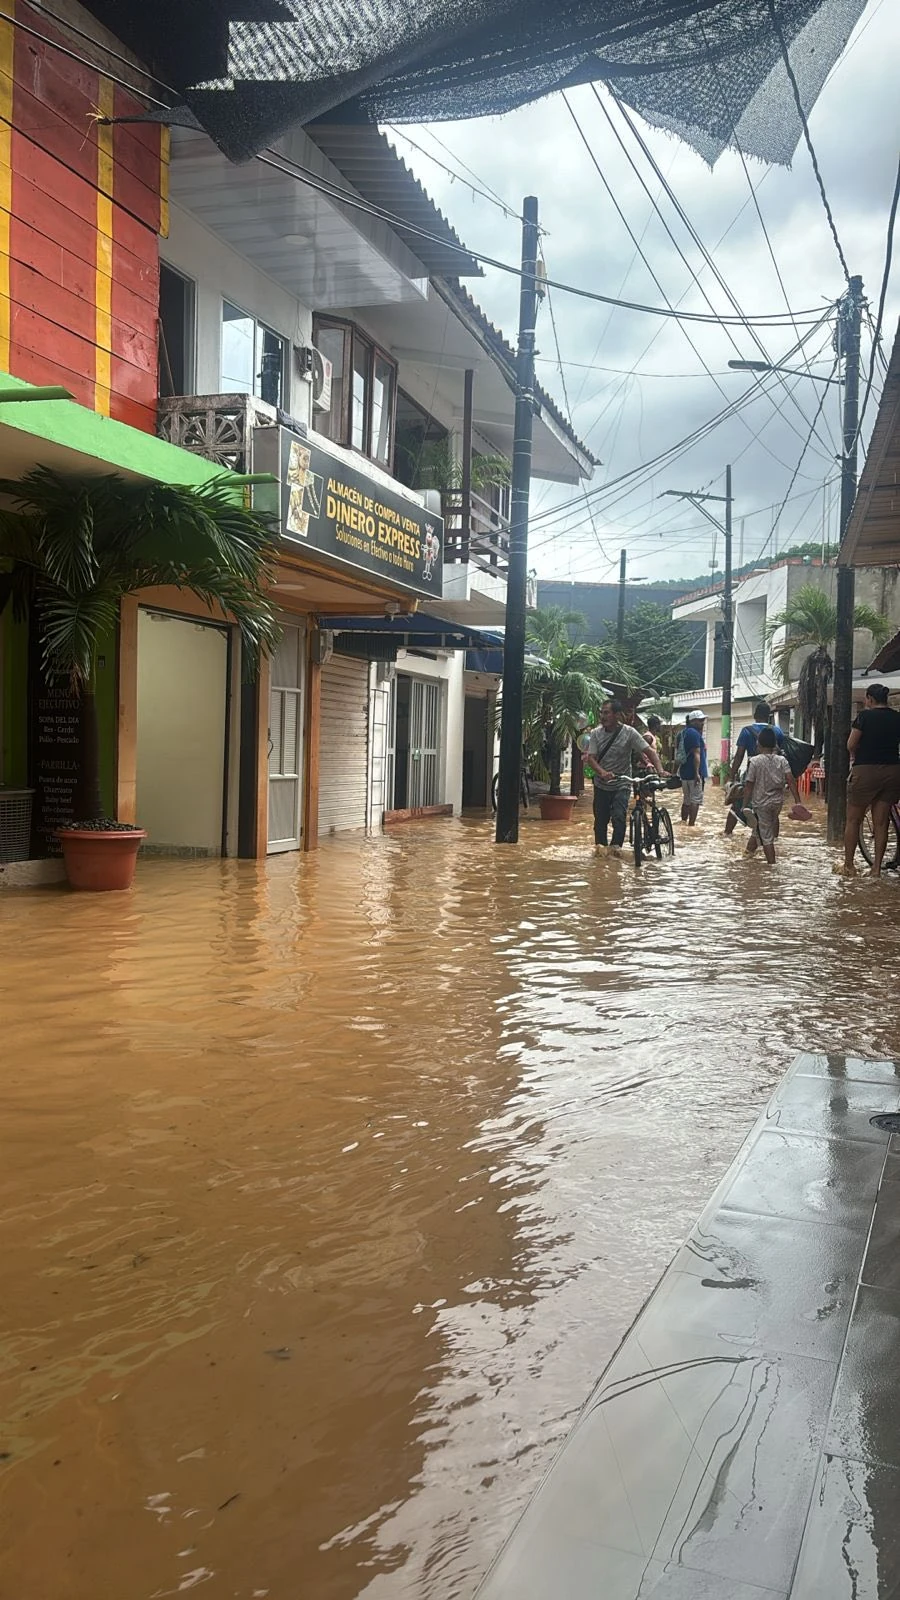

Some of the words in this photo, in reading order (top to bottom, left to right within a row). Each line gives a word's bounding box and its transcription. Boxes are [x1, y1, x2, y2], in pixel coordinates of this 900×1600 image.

[326, 495, 375, 538] DINERO
[377, 520, 421, 560] EXPRESS
[327, 477, 363, 507] ALMACÉN
[364, 496, 374, 513] DE
[374, 502, 401, 527] COMPRA
[401, 515, 421, 537] VENTA
[335, 523, 363, 551] Soluciones
[363, 541, 370, 554] en
[370, 539, 388, 562] Efectivo
